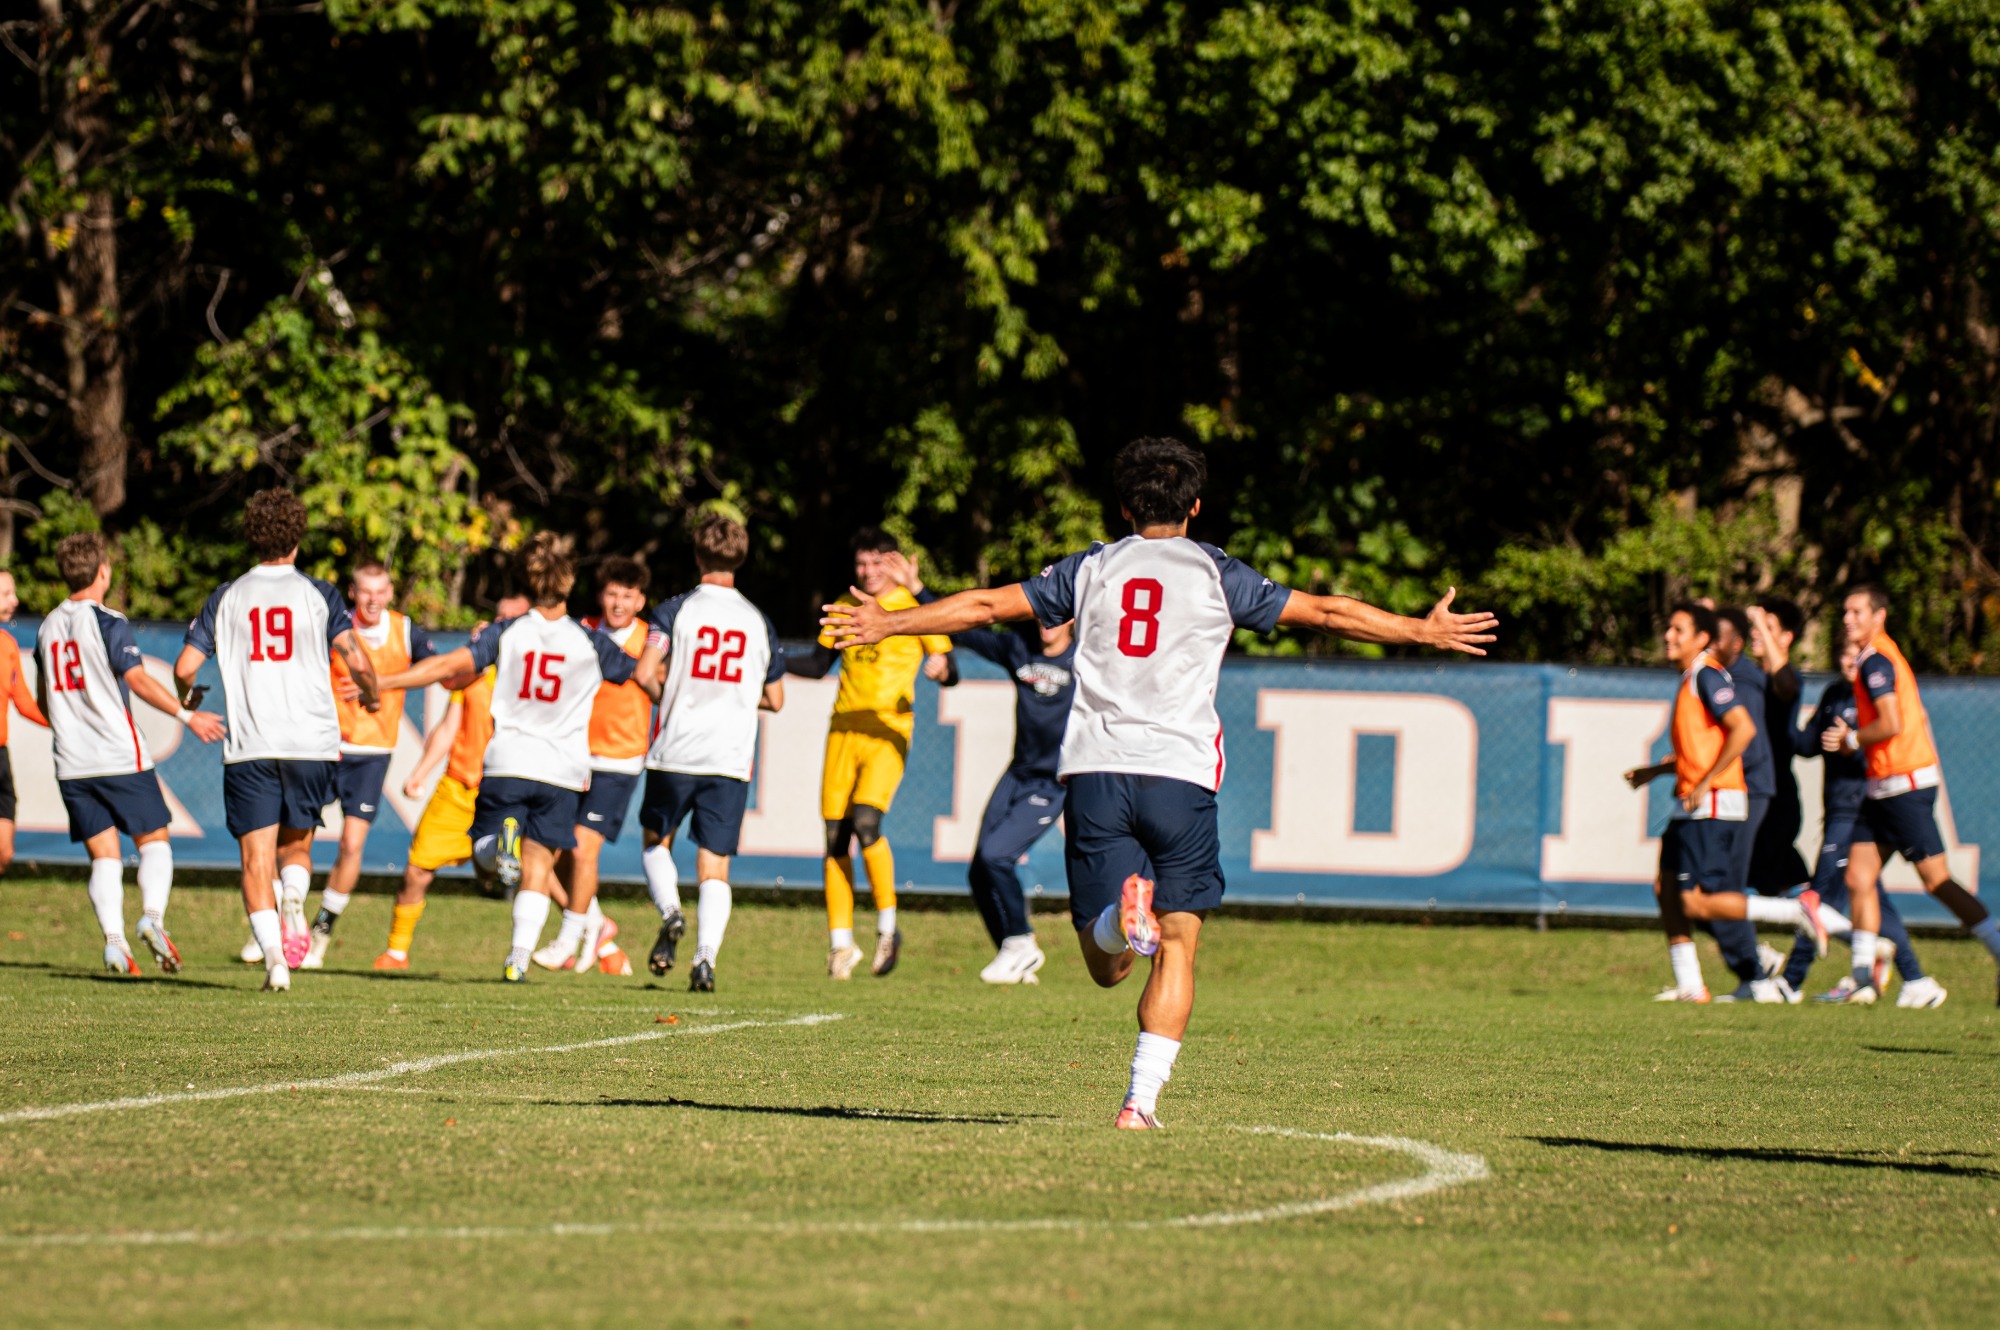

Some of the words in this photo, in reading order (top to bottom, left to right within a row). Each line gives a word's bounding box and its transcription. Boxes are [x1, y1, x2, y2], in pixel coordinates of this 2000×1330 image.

[248, 606, 293, 662] 19
[1117, 578, 1163, 658] 8
[51, 640, 85, 692] 12
[518, 650, 566, 703] 15
[690, 625, 747, 683] 22
